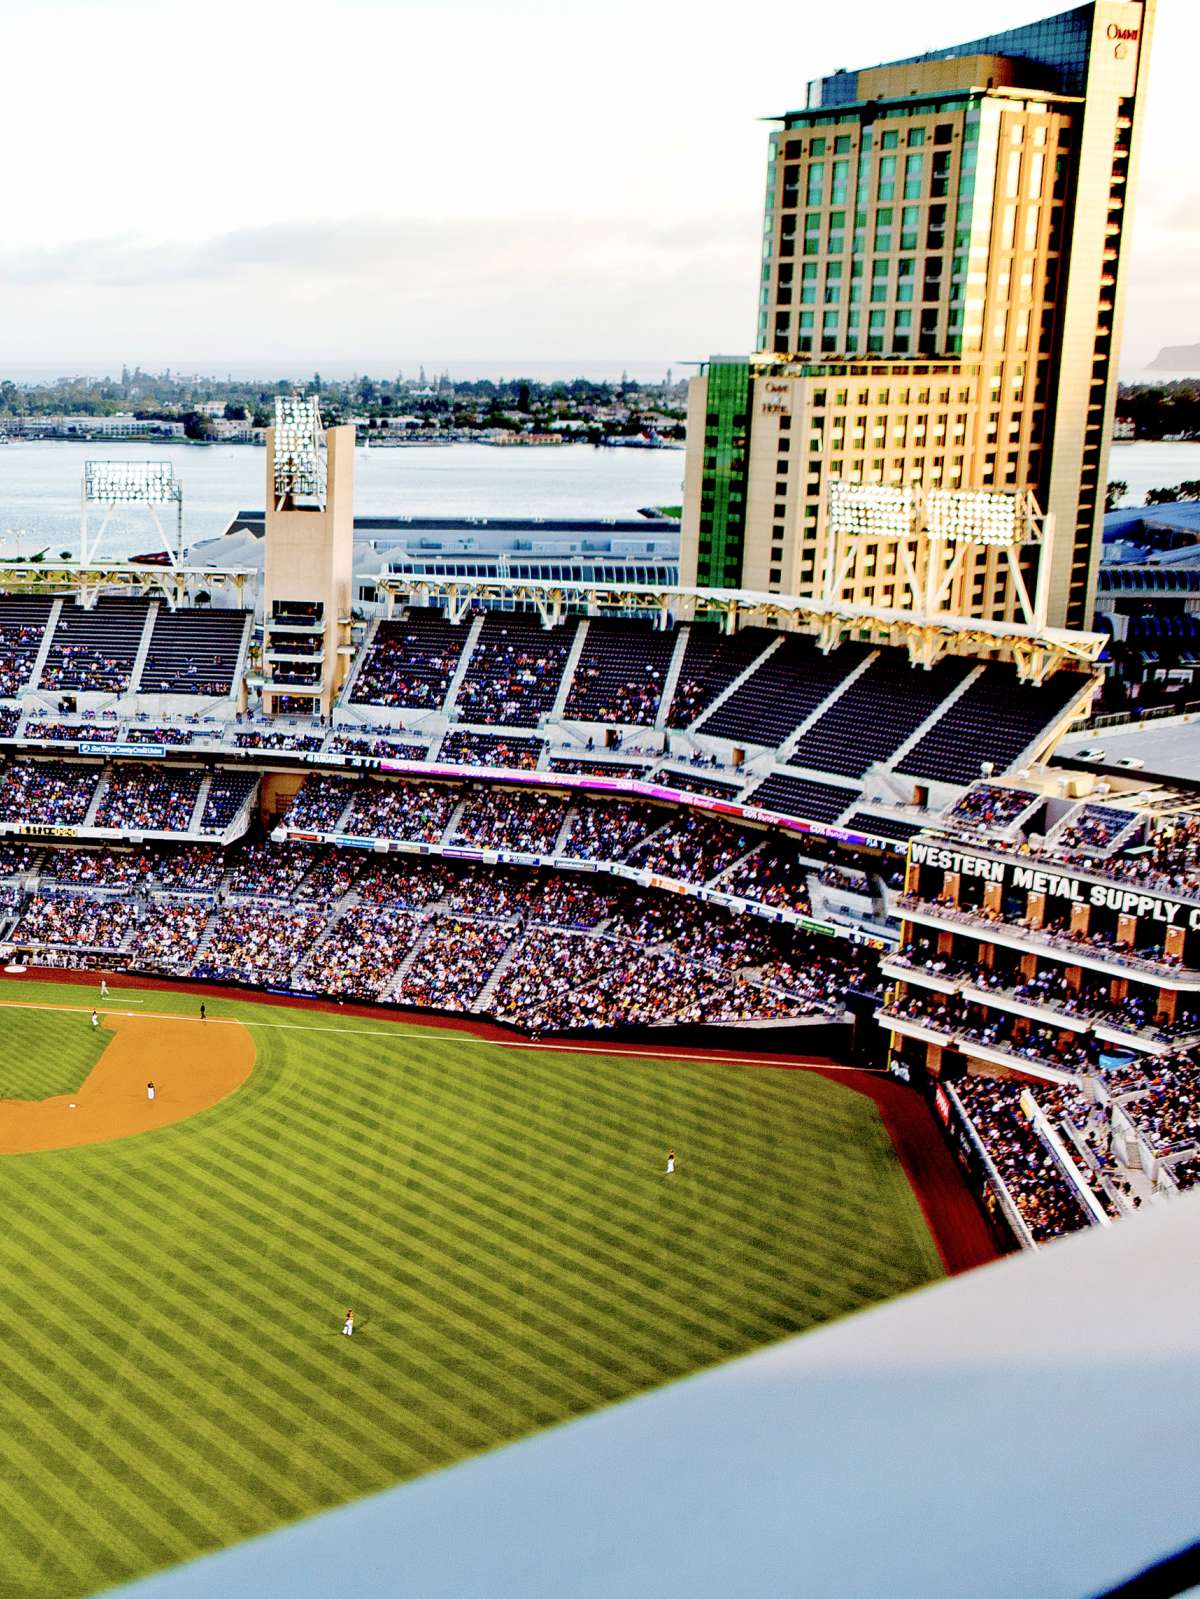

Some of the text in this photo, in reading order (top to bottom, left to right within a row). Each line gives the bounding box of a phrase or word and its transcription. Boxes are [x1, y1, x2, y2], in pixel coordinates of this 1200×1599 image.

[911, 843, 1005, 882] WESTERN
[1013, 866, 1085, 902] METAL
[1089, 885, 1182, 923] SUPPLY
